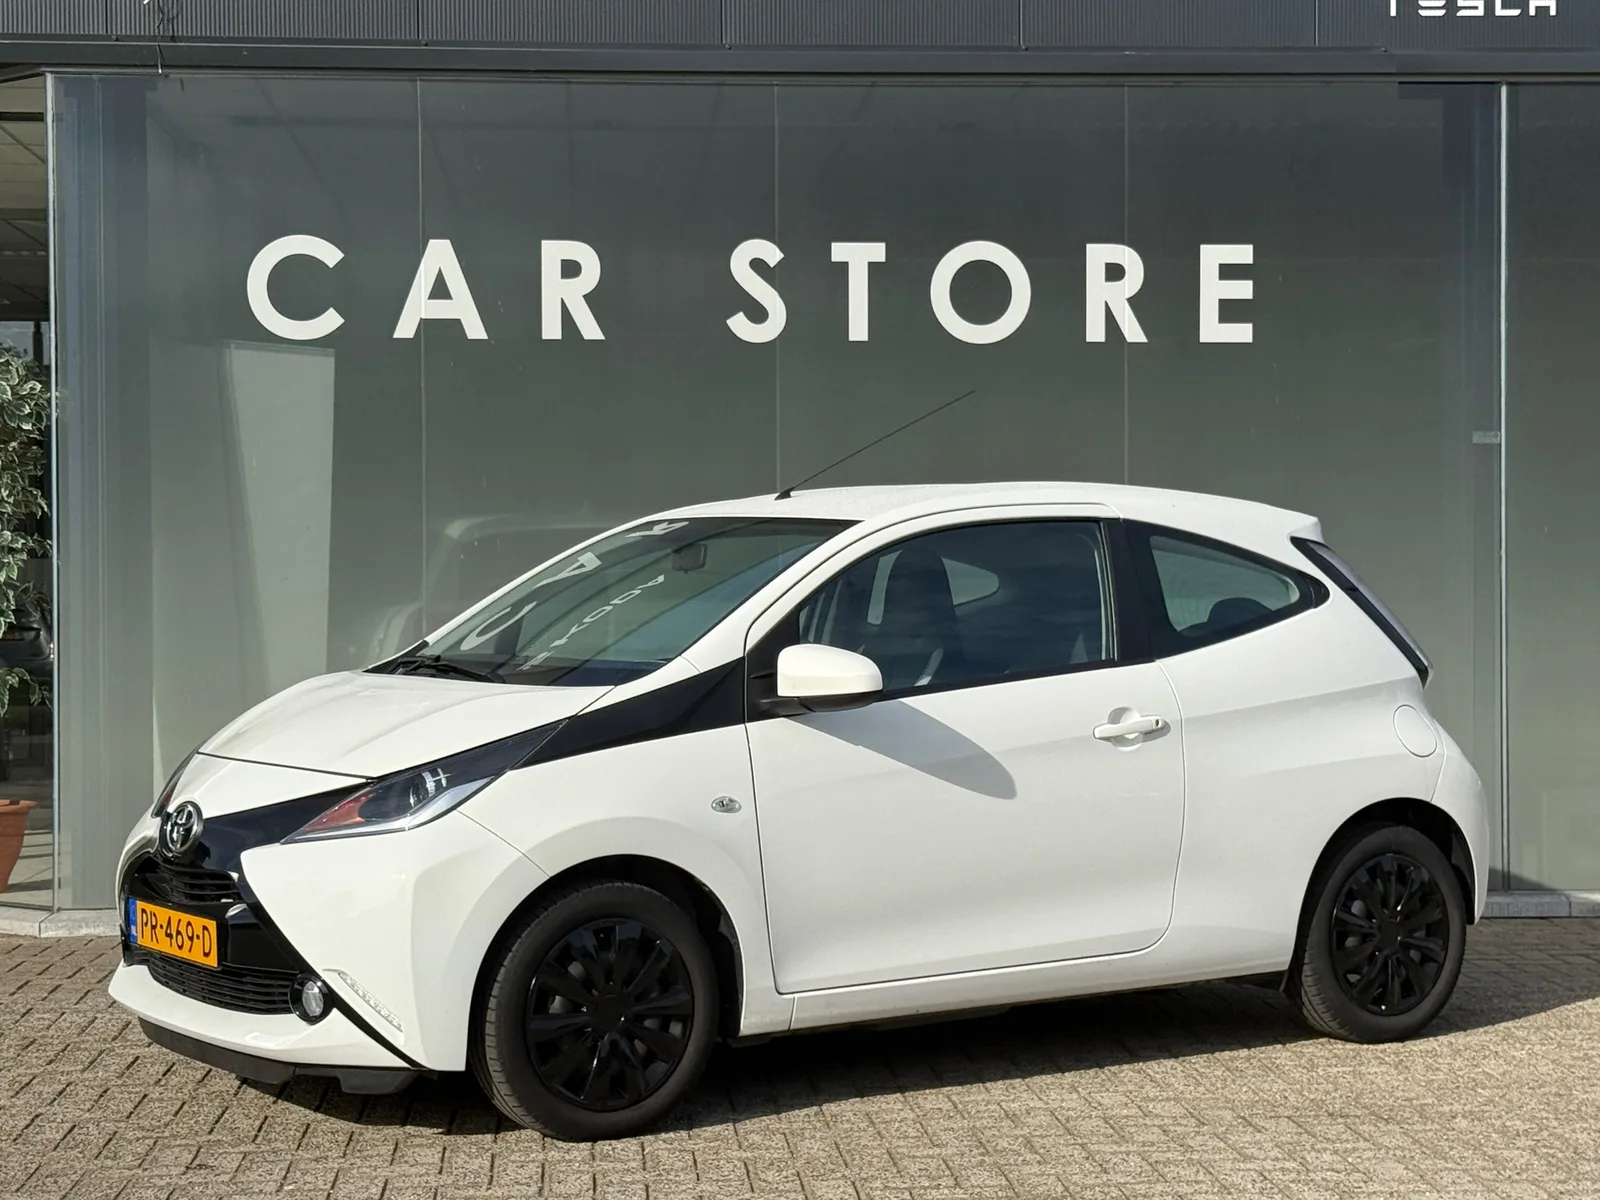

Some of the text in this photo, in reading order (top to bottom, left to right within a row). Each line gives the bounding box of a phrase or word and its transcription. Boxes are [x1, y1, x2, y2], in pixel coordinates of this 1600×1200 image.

[247, 235, 1253, 343] CAR STORE
[141, 908, 212, 958] PR-469-D
